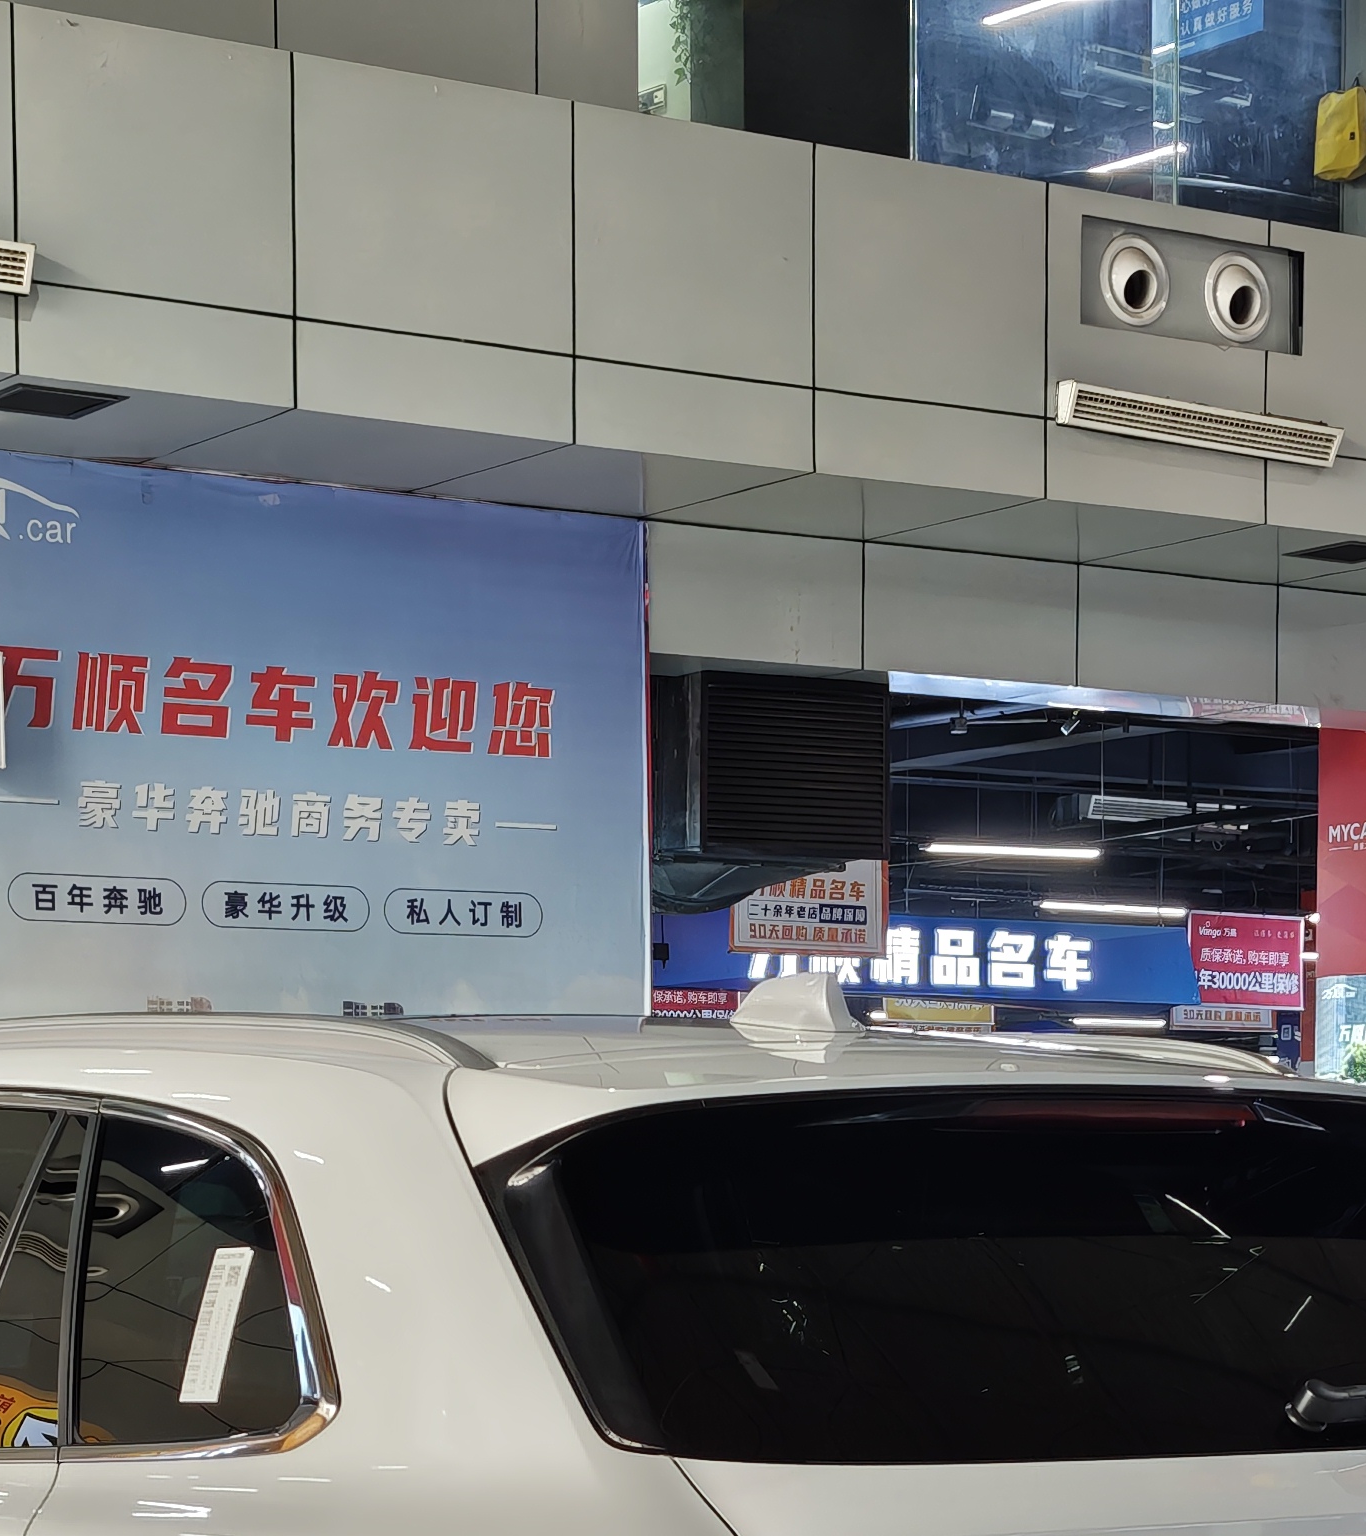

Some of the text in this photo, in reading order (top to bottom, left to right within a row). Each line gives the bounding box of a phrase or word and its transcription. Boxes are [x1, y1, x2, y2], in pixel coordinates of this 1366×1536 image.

[76, 780, 482, 848] 豪华奔驰商务专卖
[32, 882, 524, 930] 百年奔驰 豪华升级 私人订制
